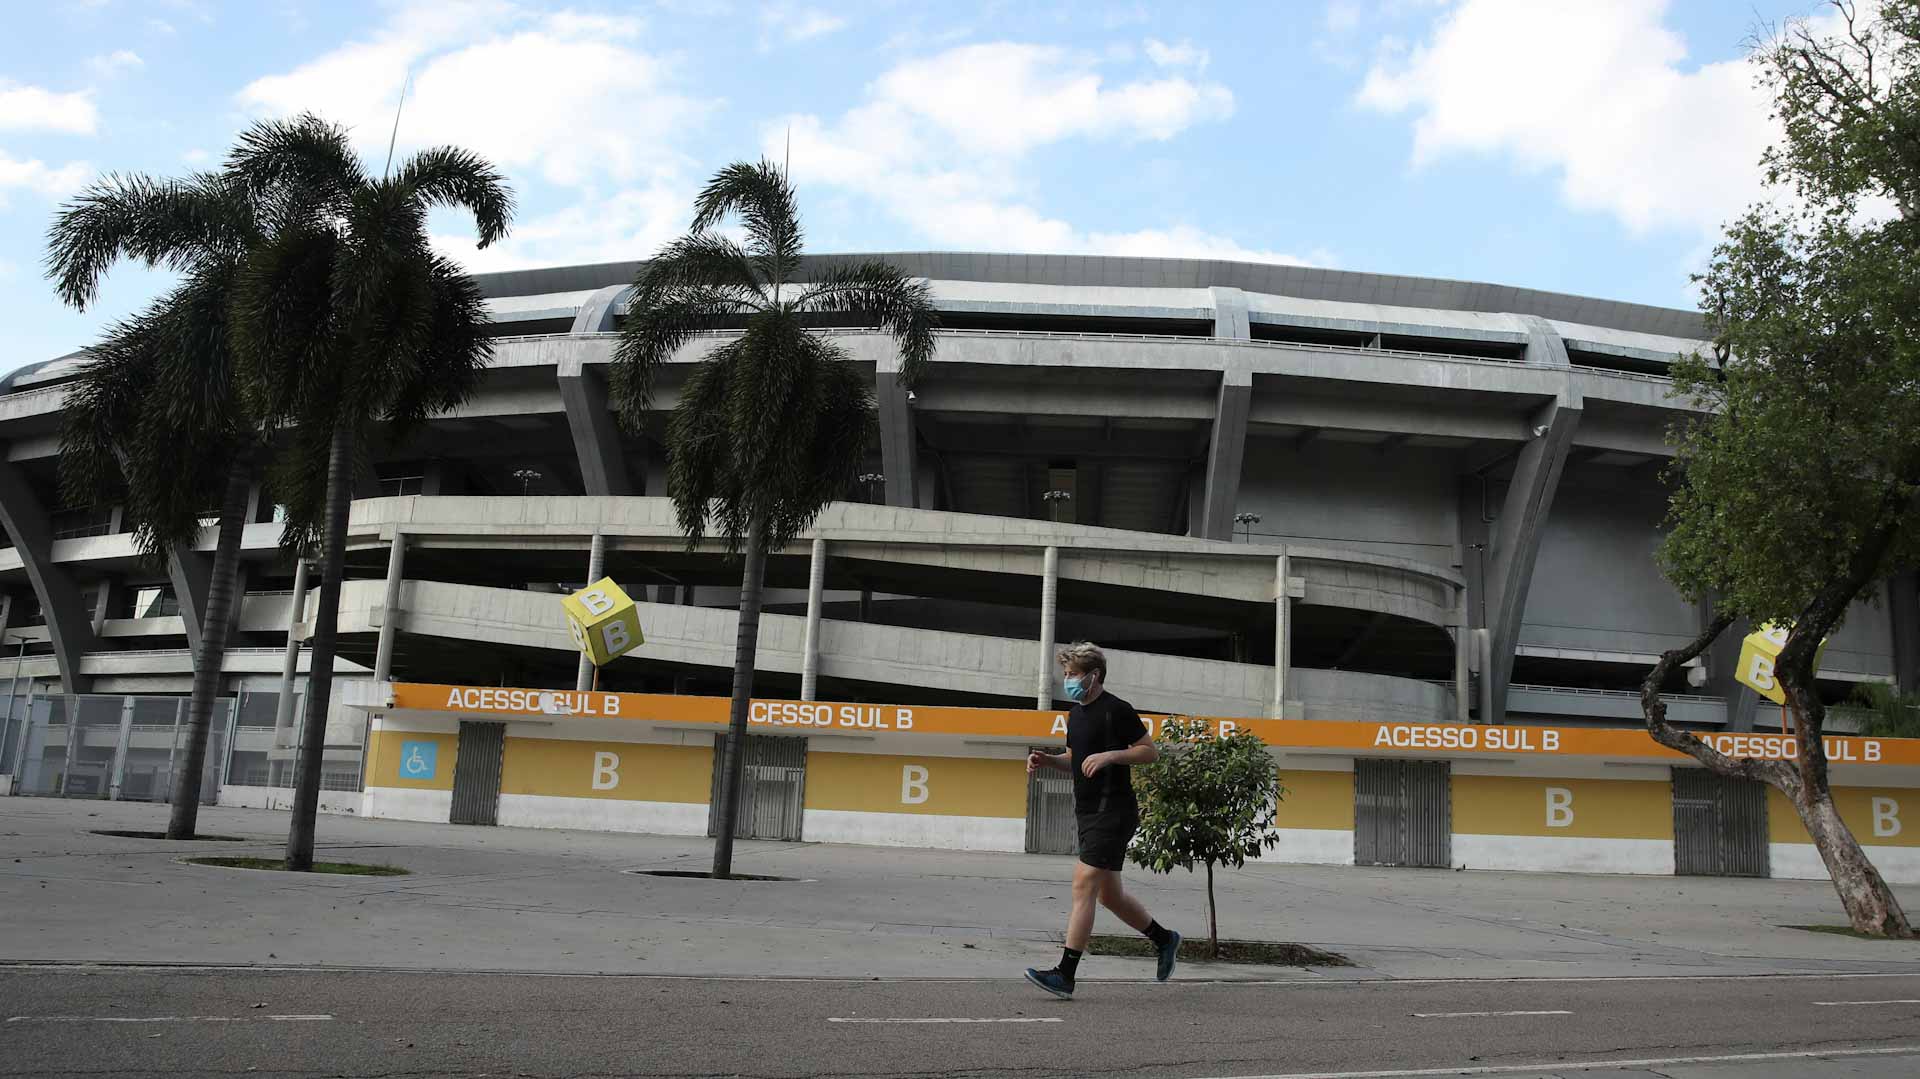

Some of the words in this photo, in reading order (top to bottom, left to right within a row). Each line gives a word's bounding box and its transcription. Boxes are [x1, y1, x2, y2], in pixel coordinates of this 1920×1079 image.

[579, 590, 615, 616] B
[602, 620, 630, 655] B
[1749, 654, 1775, 690] B
[447, 688, 543, 711] ACESSO
[604, 695, 620, 715] B
[748, 702, 833, 727] CESSO
[839, 707, 889, 729] SUL
[896, 709, 913, 729] B
[1374, 725, 1478, 748] ACESSO
[1484, 728, 1535, 750] SUL
[1543, 730, 1560, 751] B
[1824, 739, 1857, 761] UL
[1864, 740, 1881, 761] B
[592, 751, 620, 790] B
[901, 765, 929, 805] B
[1545, 787, 1574, 827] B
[1871, 797, 1901, 837] B
